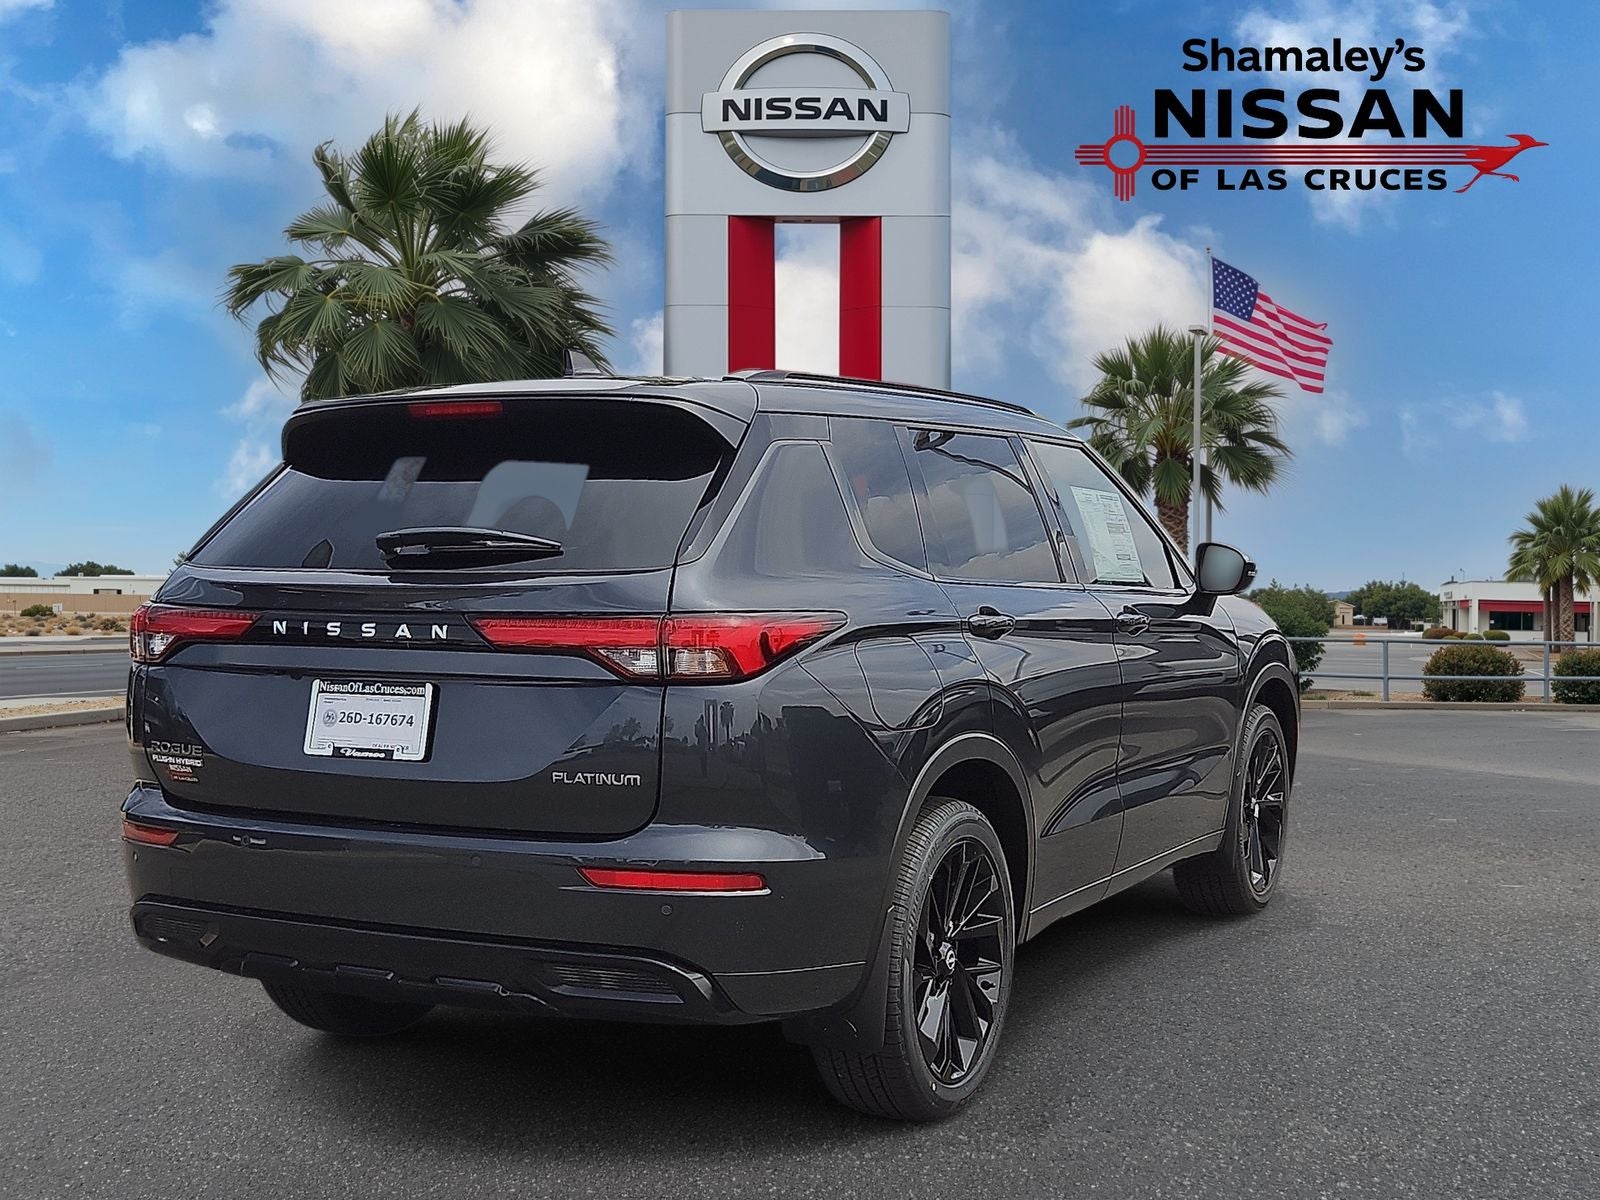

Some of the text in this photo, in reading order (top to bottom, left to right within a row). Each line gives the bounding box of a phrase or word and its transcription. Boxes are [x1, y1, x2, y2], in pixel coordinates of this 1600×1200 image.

[722, 97, 888, 122] NISSAN
[273, 620, 449, 639] NISSAN
[319, 681, 425, 695] NissanOfLasCruces.com
[338, 711, 415, 727] 26D-167674
[151, 740, 203, 756] ROGUE
[552, 771, 641, 786] PLATINUM
